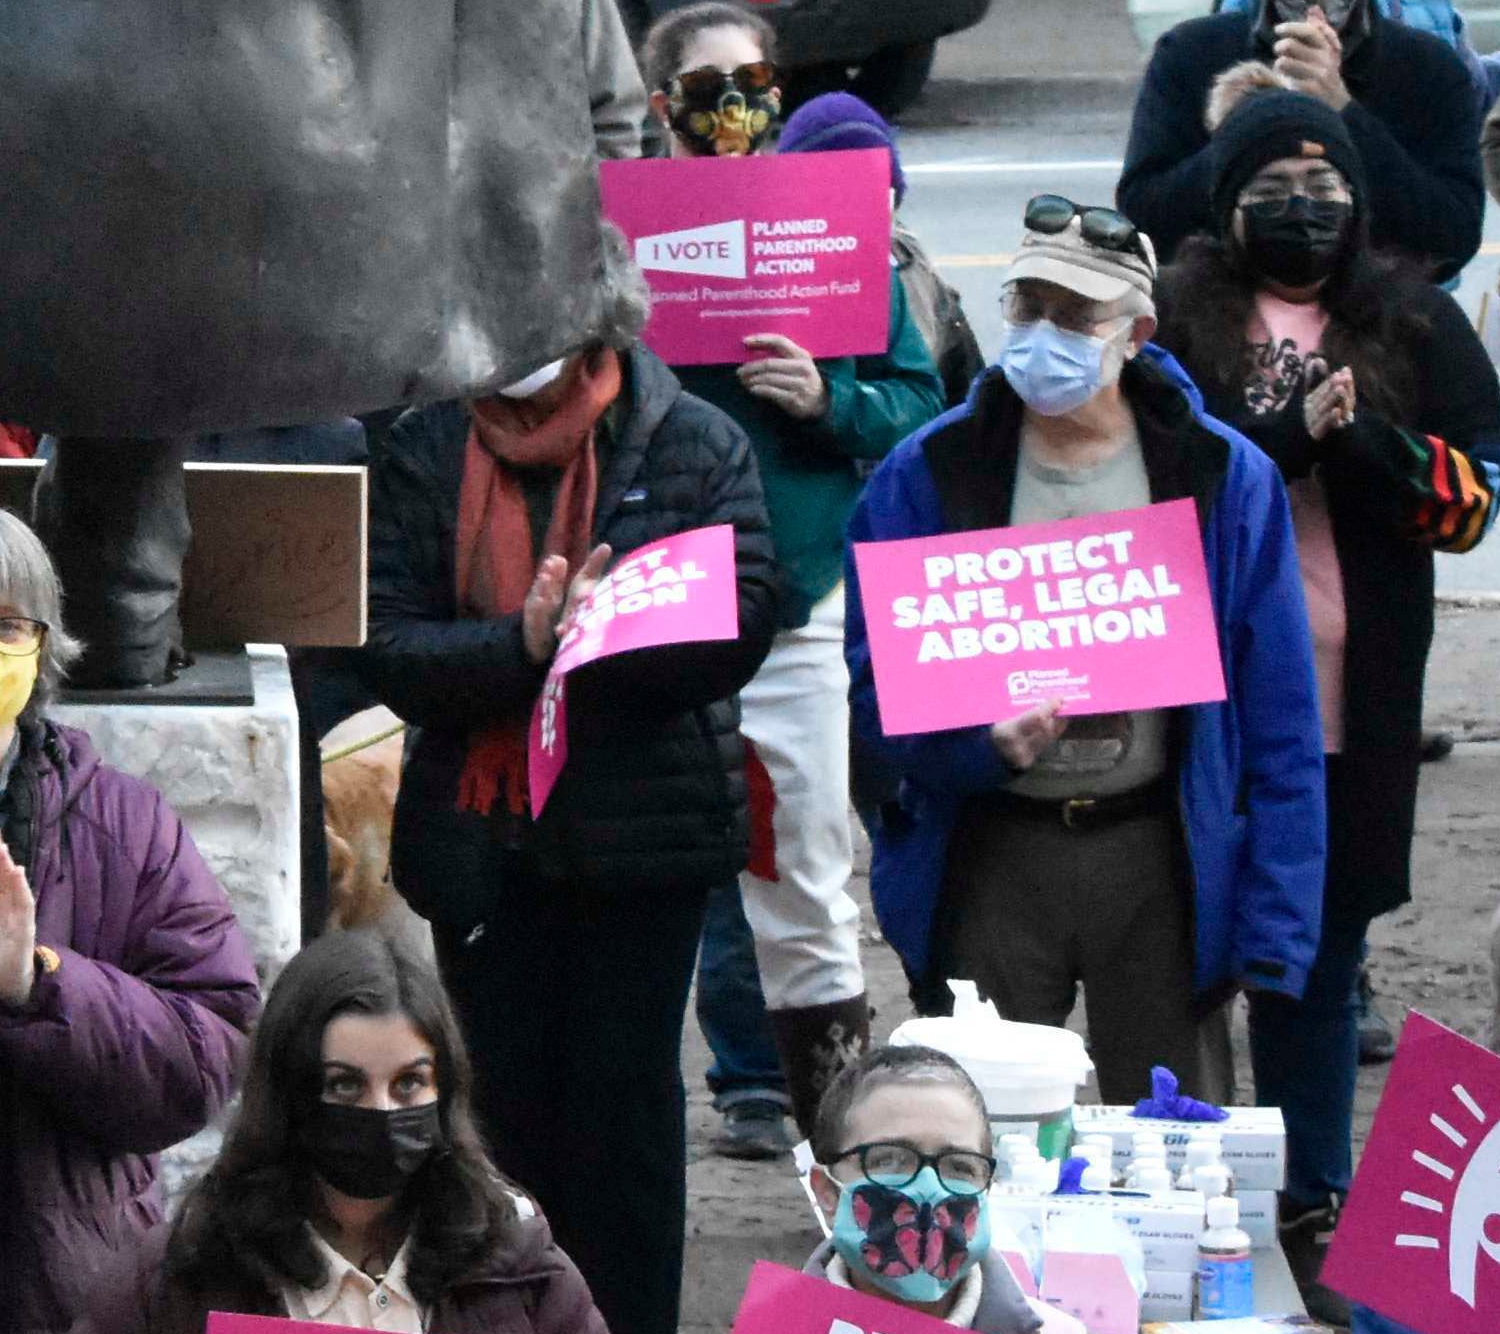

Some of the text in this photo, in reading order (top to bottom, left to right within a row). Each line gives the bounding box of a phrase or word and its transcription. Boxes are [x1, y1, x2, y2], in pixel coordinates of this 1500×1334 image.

[752, 218, 828, 237] PLANNED
[653, 240, 730, 260] I VOTE
[752, 236, 858, 256] PARENTHOOD
[754, 258, 816, 276] ACTION
[702, 285, 788, 302] Parenthood
[790, 282, 829, 298] Action
[831, 279, 861, 295] Fund
[923, 530, 1135, 589] PROTECT
[891, 564, 1182, 630] SAFE, LEGAL
[917, 604, 1168, 664] ABORTION
